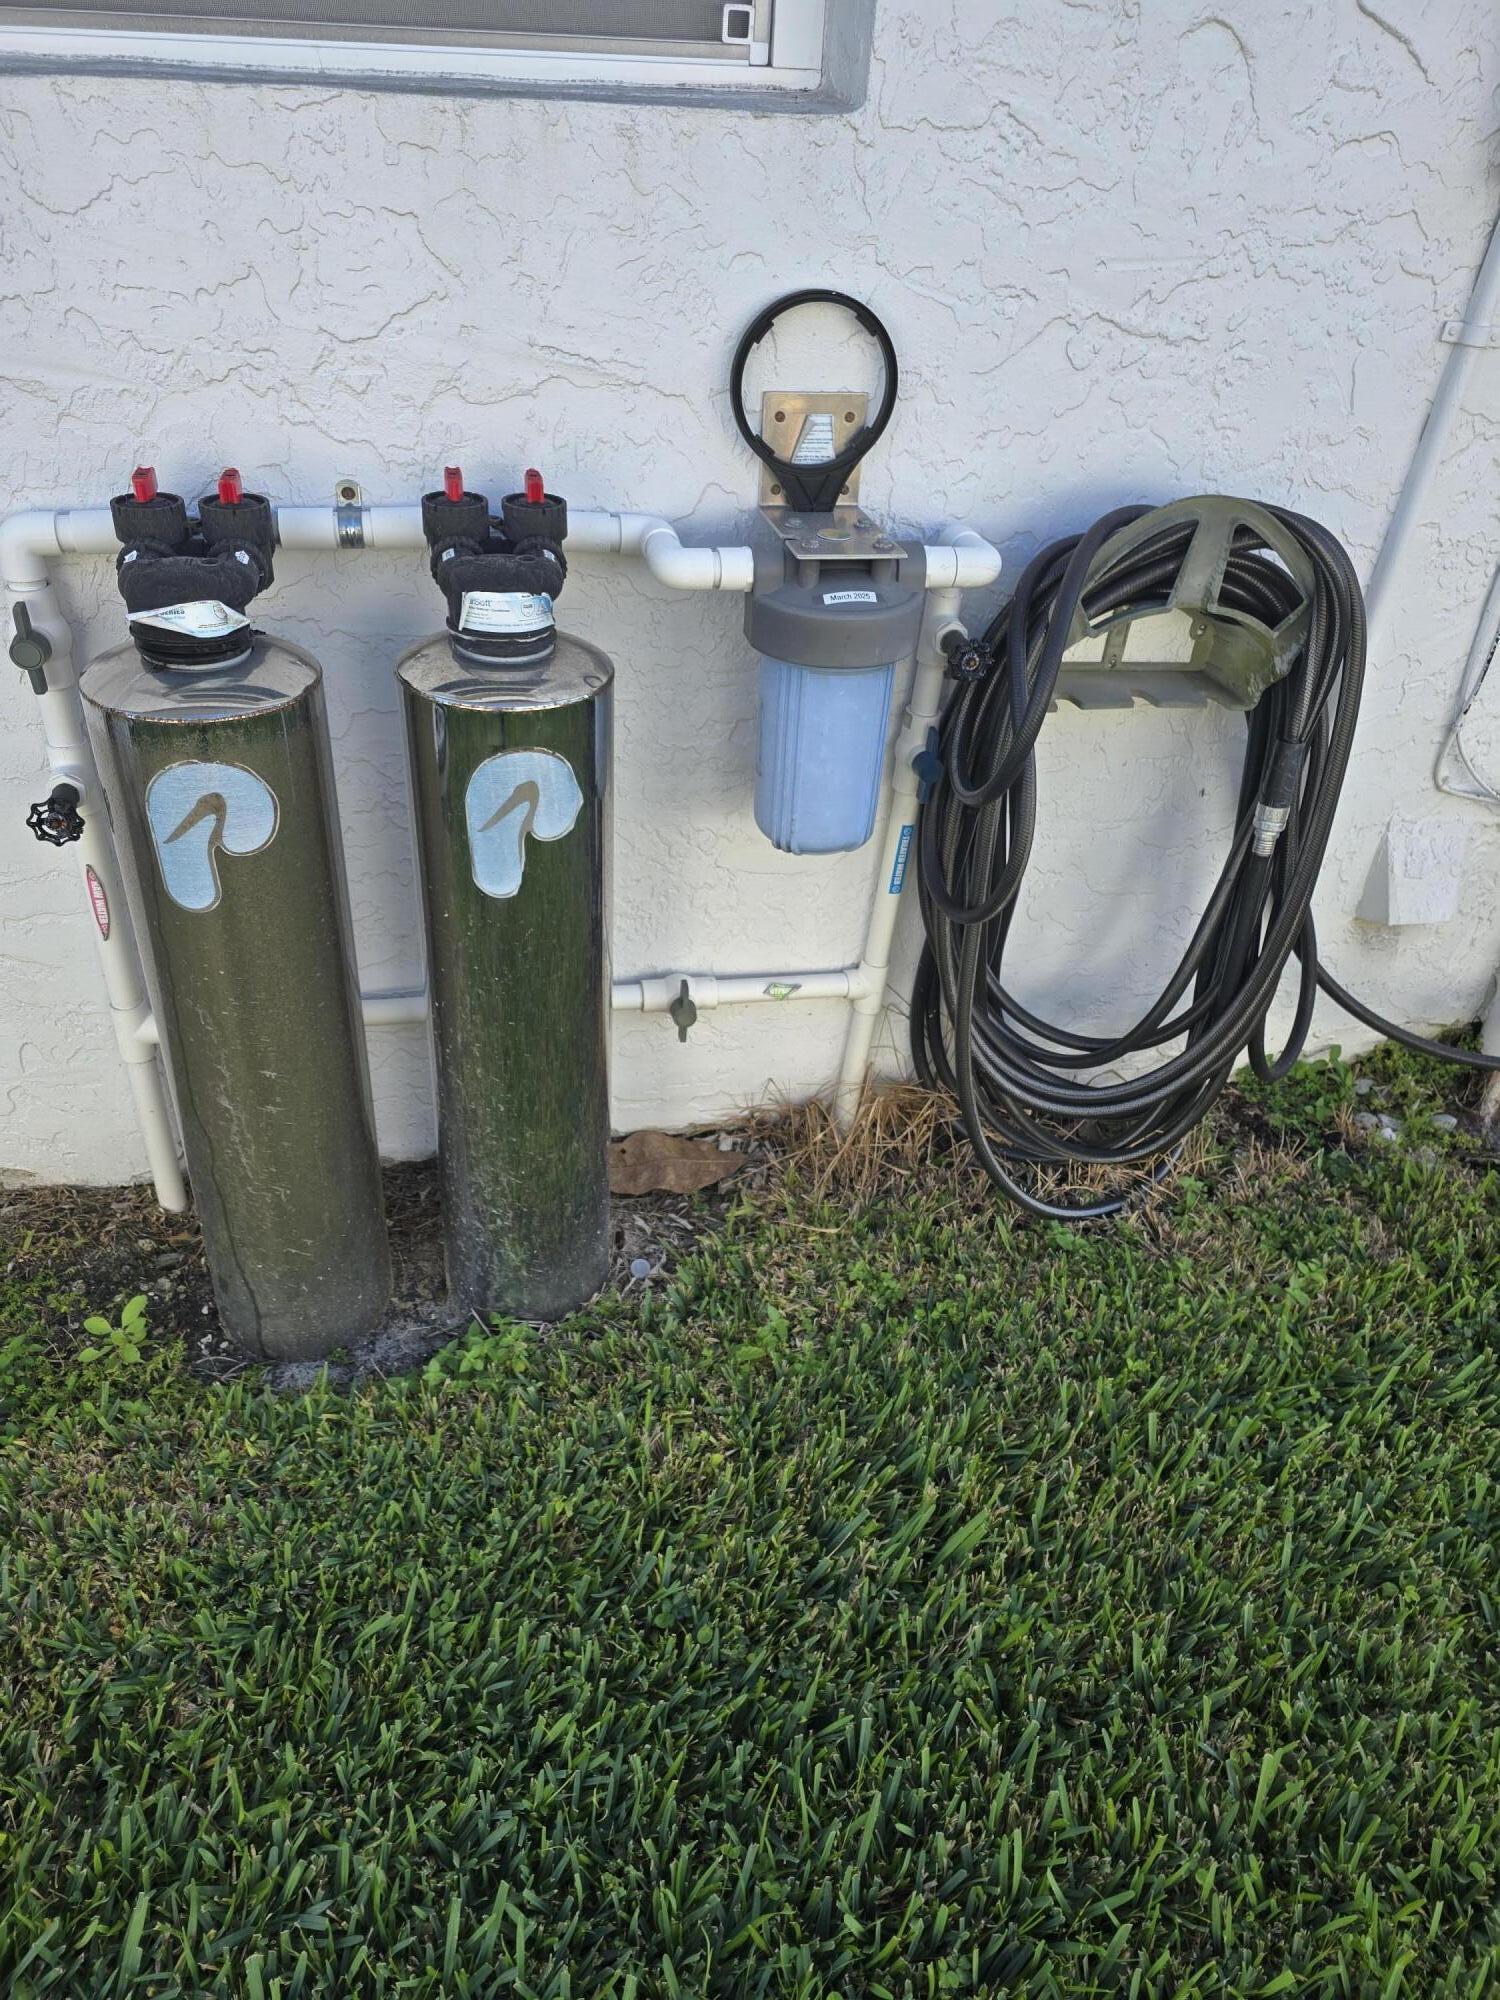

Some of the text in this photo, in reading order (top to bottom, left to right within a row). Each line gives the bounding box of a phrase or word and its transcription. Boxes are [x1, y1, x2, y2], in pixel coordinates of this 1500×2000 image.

[853, 592, 871, 600] 2025
[893, 835, 911, 886] TREATED WATER
[90, 879, 109, 924] RAW WATER
